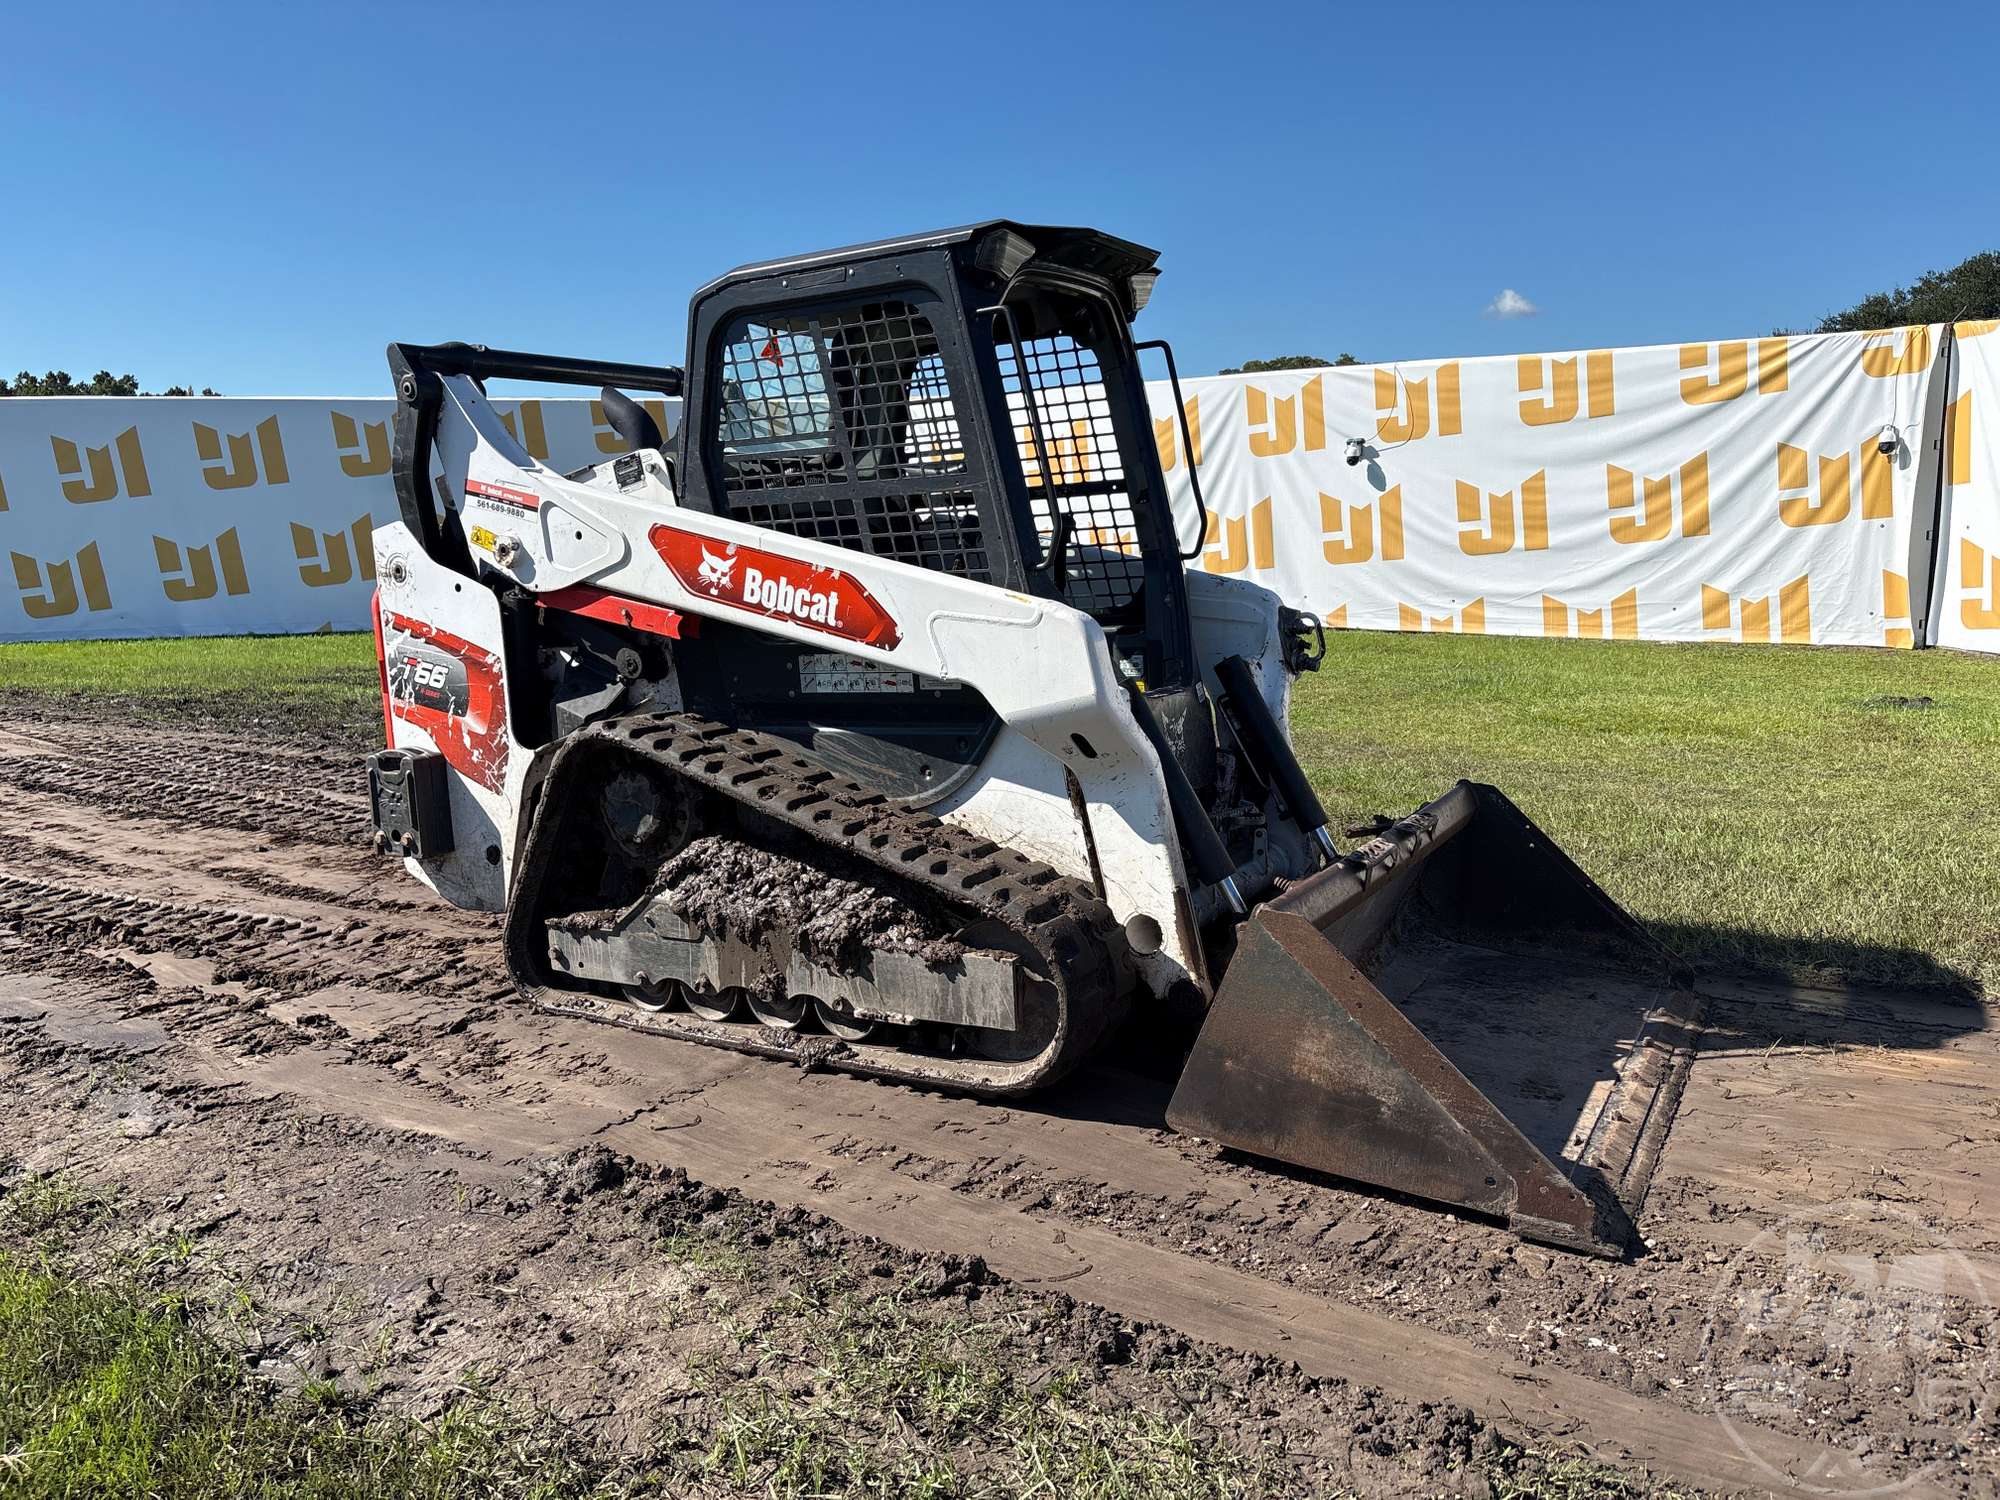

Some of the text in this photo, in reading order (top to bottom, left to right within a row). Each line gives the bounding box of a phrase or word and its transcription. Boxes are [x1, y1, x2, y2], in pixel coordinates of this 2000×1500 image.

[476, 499, 525, 518] 561-689-9880
[743, 567, 840, 628] Bobcat
[402, 656, 450, 689] T66
